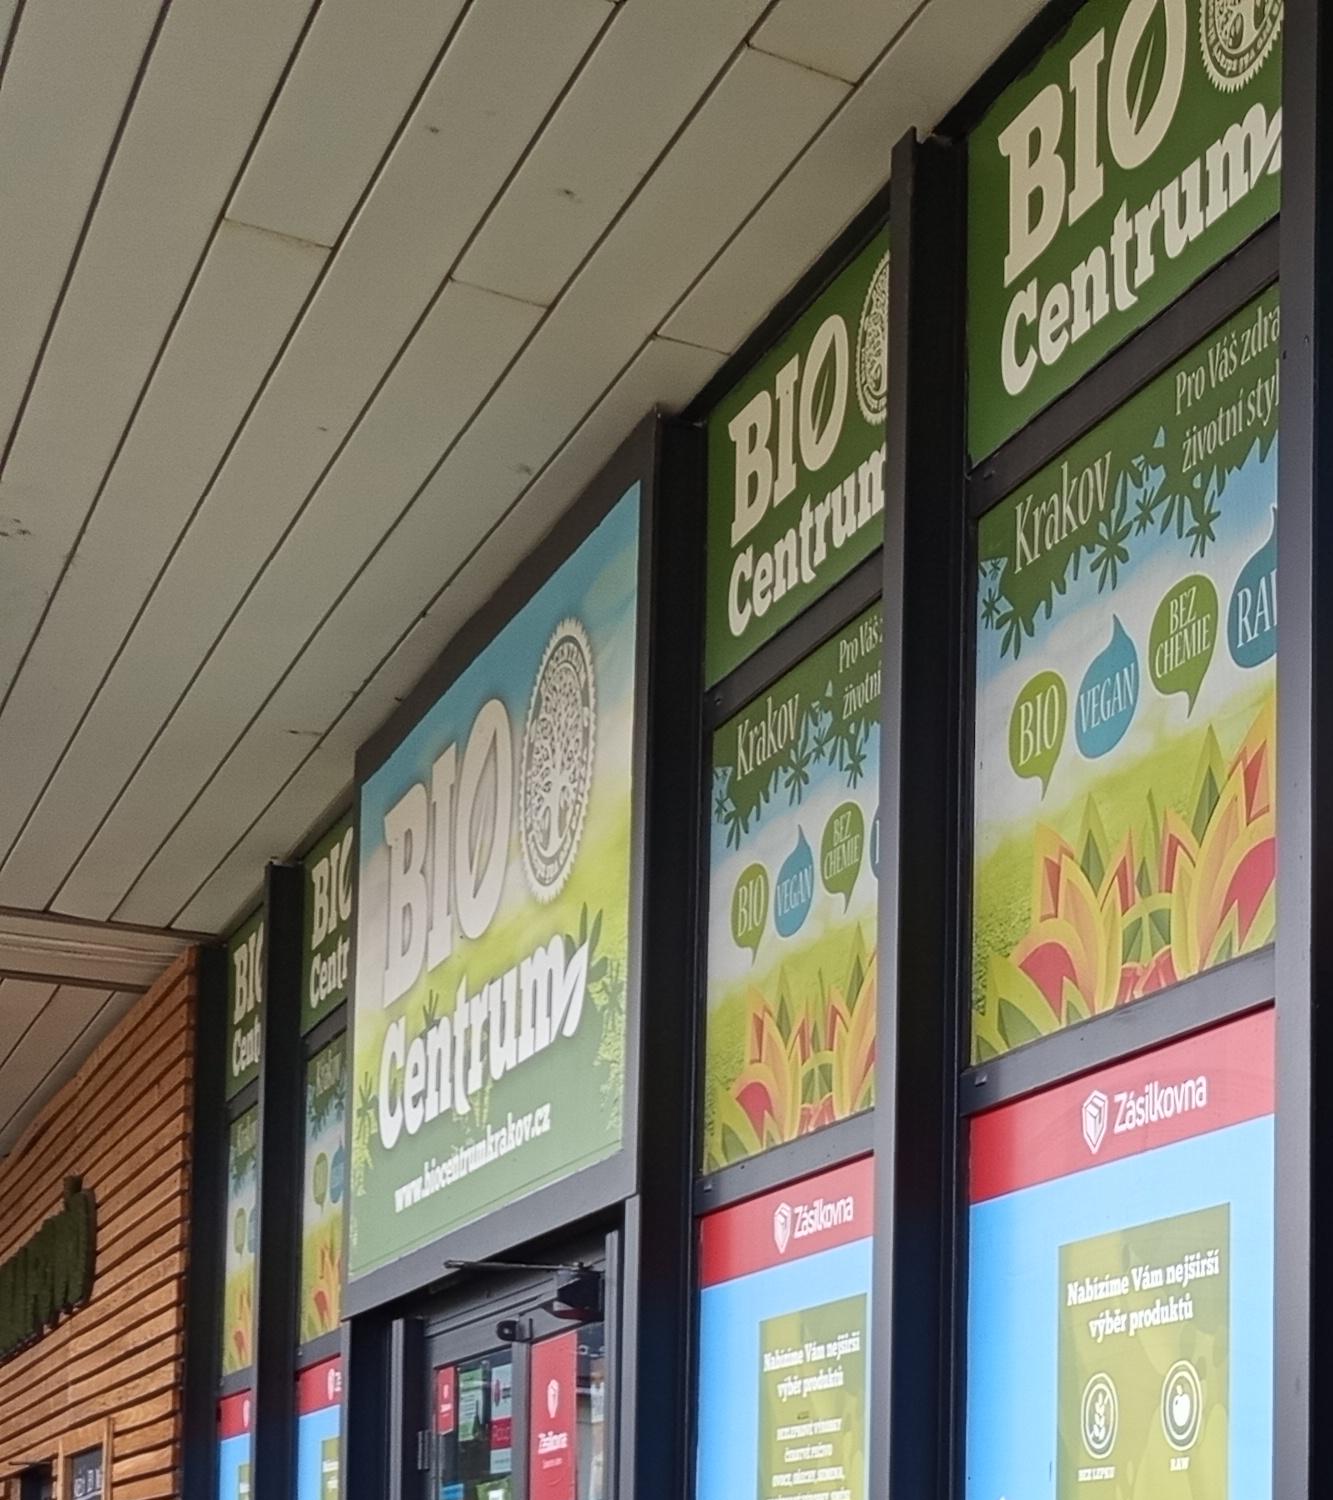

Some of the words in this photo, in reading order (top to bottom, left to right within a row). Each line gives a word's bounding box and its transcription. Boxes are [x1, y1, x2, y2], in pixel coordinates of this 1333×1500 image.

[998, 0, 1187, 288] BIO
[1001, 103, 1283, 395] Centrum
[1175, 366, 1205, 415] Pro
[1210, 339, 1238, 389] Váš
[728, 314, 849, 548] BIO
[1181, 405, 1245, 473] životní
[1013, 451, 1112, 574] Krakov
[1169, 586, 1198, 633] BEZ
[1237, 568, 1277, 648] RA
[838, 637, 858, 674] Pro
[1155, 613, 1211, 679] CHEMIE
[1019, 684, 1059, 767] BIO
[1079, 663, 1135, 734] VEGAN
[737, 693, 800, 781] Krakov
[383, 698, 514, 1010] BIO
[738, 875, 764, 937] BIO
[775, 864, 813, 917] VEGAN
[379, 934, 590, 1150] Centrum
[1114, 1075, 1207, 1133] Zásilkovna
[794, 1196, 853, 1239] Zásilkovna
[1067, 1273, 1129, 1307] Nabízíme
[1131, 1262, 1163, 1292] Vám
[1166, 1250, 1219, 1290] nejširší
[1129, 1294, 1193, 1336] produktů
